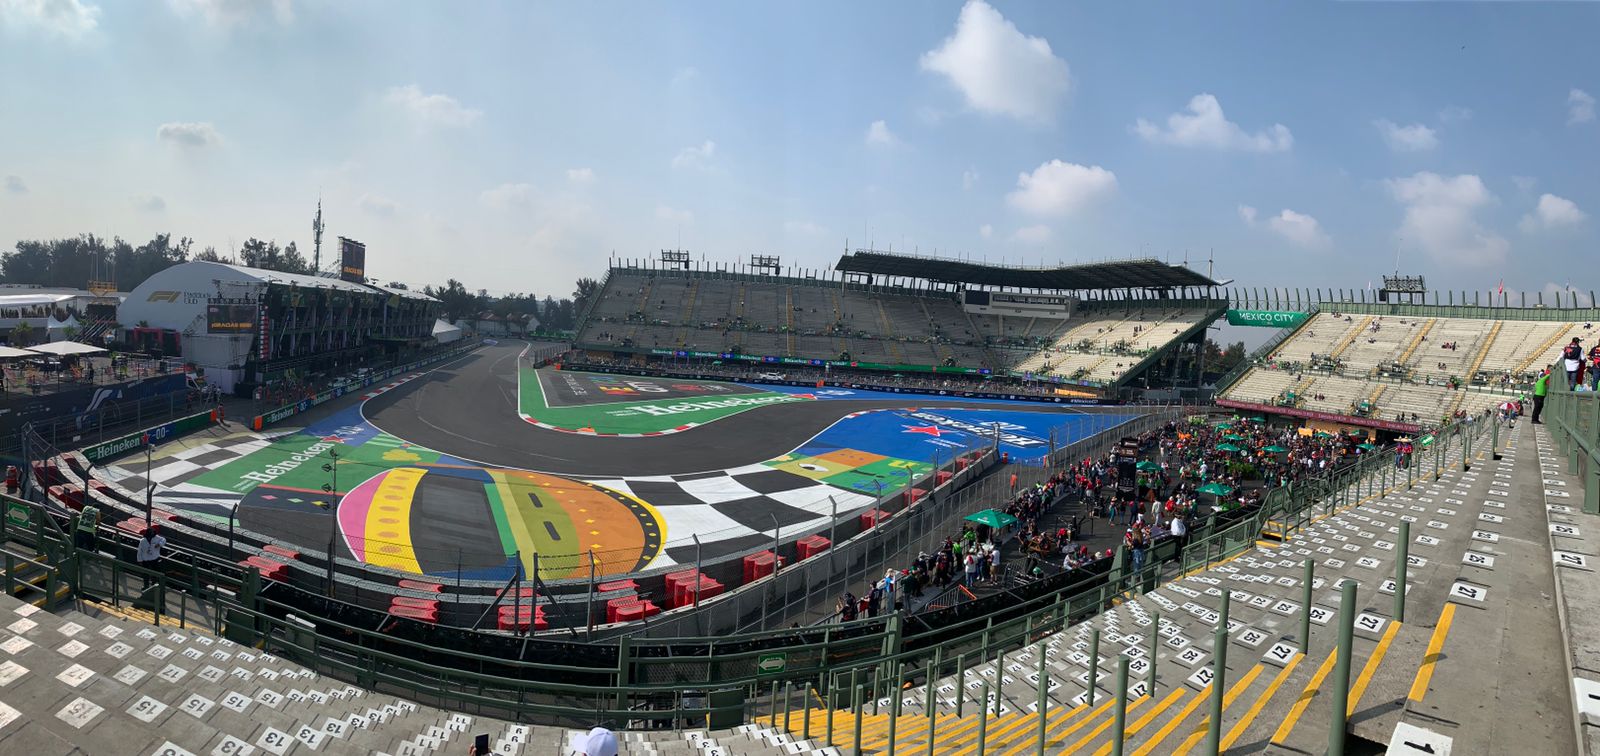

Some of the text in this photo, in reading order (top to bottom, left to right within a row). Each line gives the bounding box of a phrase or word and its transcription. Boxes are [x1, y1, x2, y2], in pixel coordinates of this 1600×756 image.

[1239, 312, 1294, 322] MEXICO CITY
[96, 437, 140, 459] Heineken
[240, 440, 336, 484] Heineken
[1468, 554, 1485, 564] 25
[1560, 554, 1582, 565] 27
[1458, 586, 1478, 599] 27
[1254, 596, 1266, 605] 21
[1277, 603, 1292, 612] 23
[1206, 613, 1218, 621] 21
[1310, 609, 1326, 619] 25
[1359, 616, 1379, 630] 27
[1166, 627, 1177, 635] 21
[1127, 635, 1139, 643] 21
[1170, 637, 1185, 646] 23
[1244, 632, 1260, 643] 25
[185, 649, 197, 659] 19
[213, 652, 225, 660] 19
[1073, 653, 1084, 661] 17
[1127, 648, 1141, 657] 23
[1182, 650, 1198, 661] 25
[1272, 645, 1291, 661] 27
[1130, 660, 1147, 671] 25
[162, 668, 179, 679] 17
[203, 669, 219, 679] 17
[234, 670, 247, 679] 17
[1197, 669, 1214, 684] 27
[1134, 684, 1148, 697] 27
[227, 696, 244, 708] 15
[261, 693, 277, 704] 15
[289, 693, 304, 703] 15
[310, 693, 322, 703] 15
[136, 700, 157, 715] 15
[187, 699, 206, 712] 15
[350, 717, 365, 728] 13
[368, 712, 382, 722] 13
[326, 722, 342, 734] 13
[265, 732, 285, 748] 13
[300, 728, 316, 744] 13
[1403, 741, 1435, 755] 1
